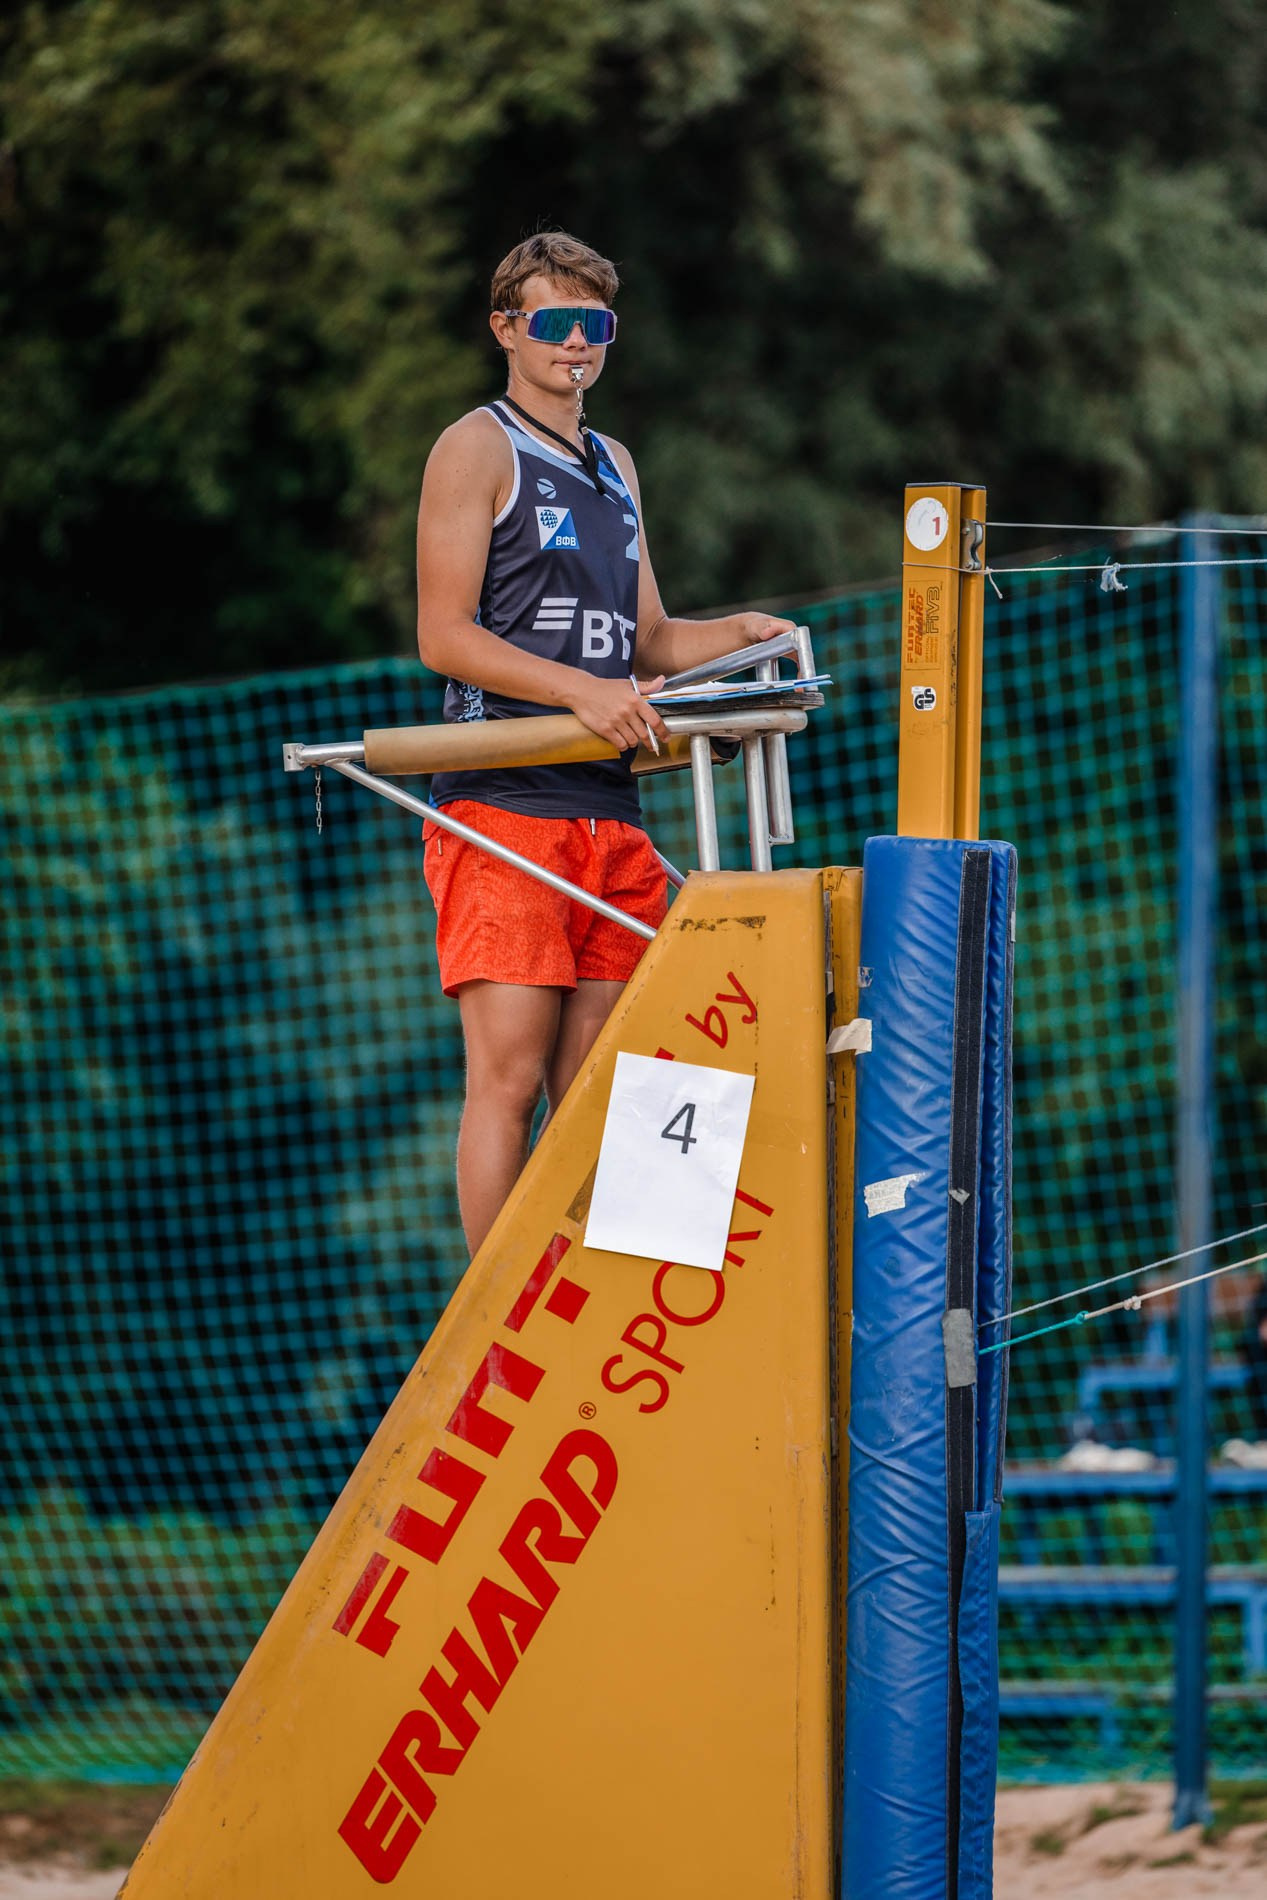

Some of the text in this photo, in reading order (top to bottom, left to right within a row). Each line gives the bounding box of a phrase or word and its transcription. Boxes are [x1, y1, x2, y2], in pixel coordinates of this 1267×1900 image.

[555, 535, 577, 547] ВФВ
[932, 516, 941, 536] 1
[914, 594, 924, 657] ERHARD
[925, 586, 941, 634] FIVB
[914, 688, 935, 710] GS
[685, 971, 758, 1049] by
[661, 1102, 697, 1155] 4
[337, 1429, 618, 1884] ERHARD
